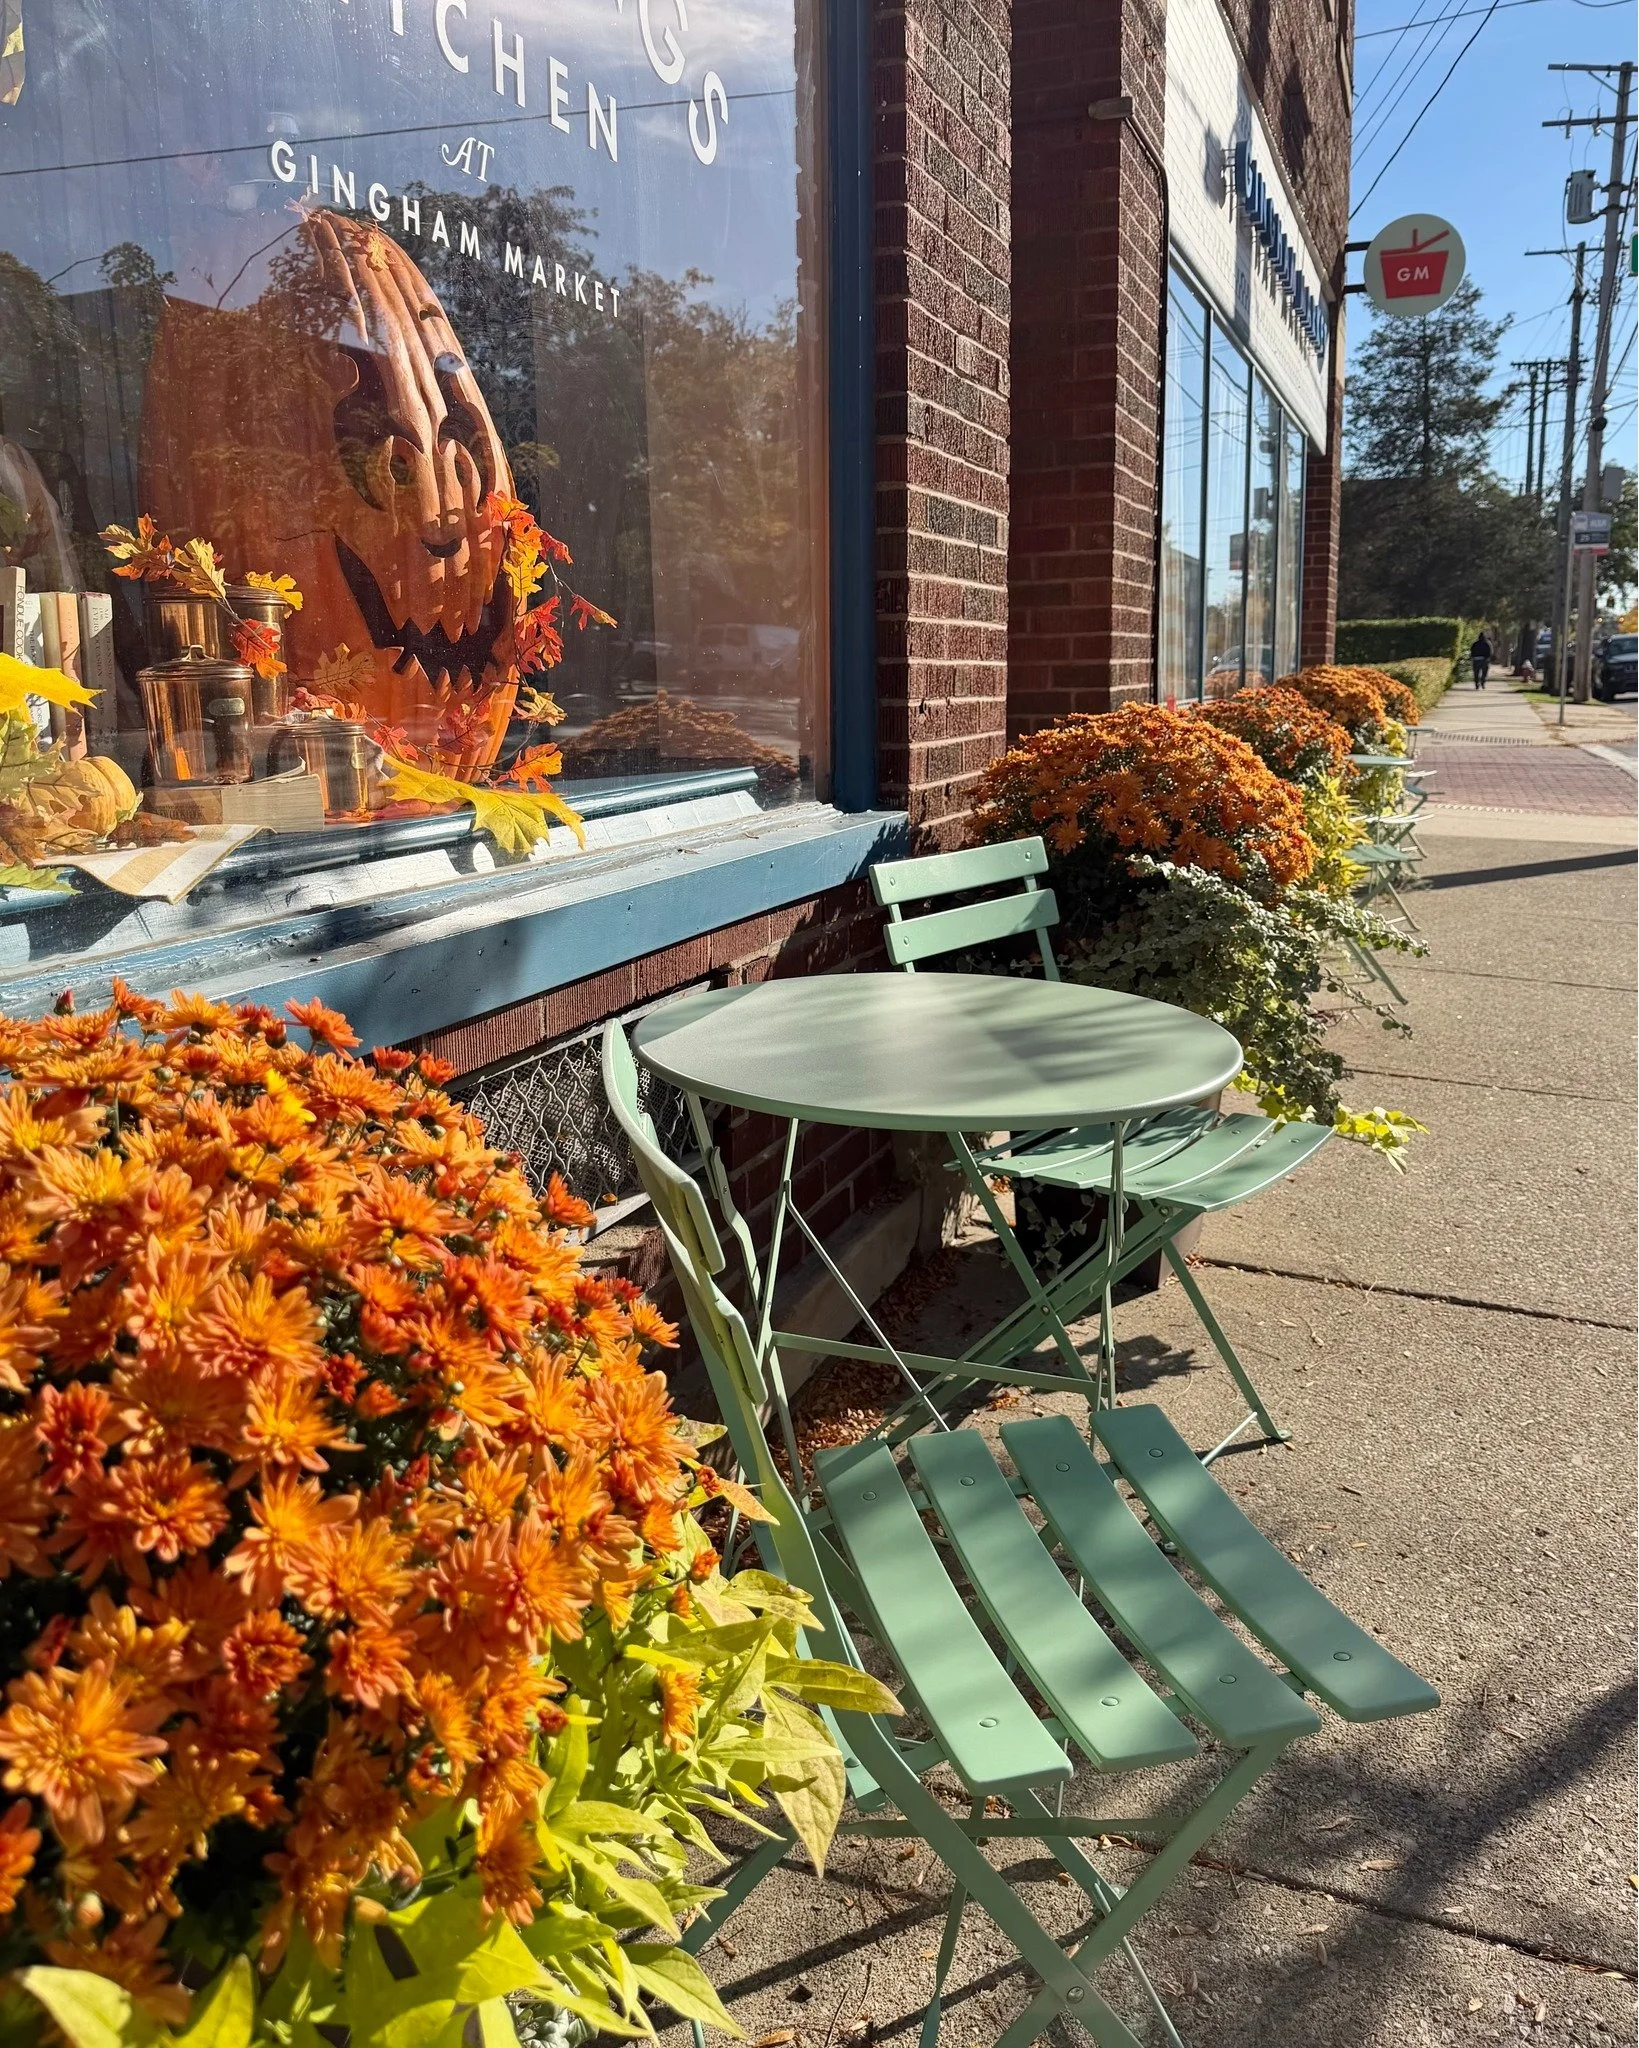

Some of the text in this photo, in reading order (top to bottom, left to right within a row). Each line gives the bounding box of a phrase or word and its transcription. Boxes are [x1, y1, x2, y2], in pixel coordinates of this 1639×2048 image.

[337, 0, 618, 163] CHEN
[616, 0, 729, 165] GS
[441, 136, 495, 182] AT
[271, 140, 620, 318] GINGHAM MARKET
[1397, 266, 1430, 282] GM
[16, 585, 25, 628] FONDUE
